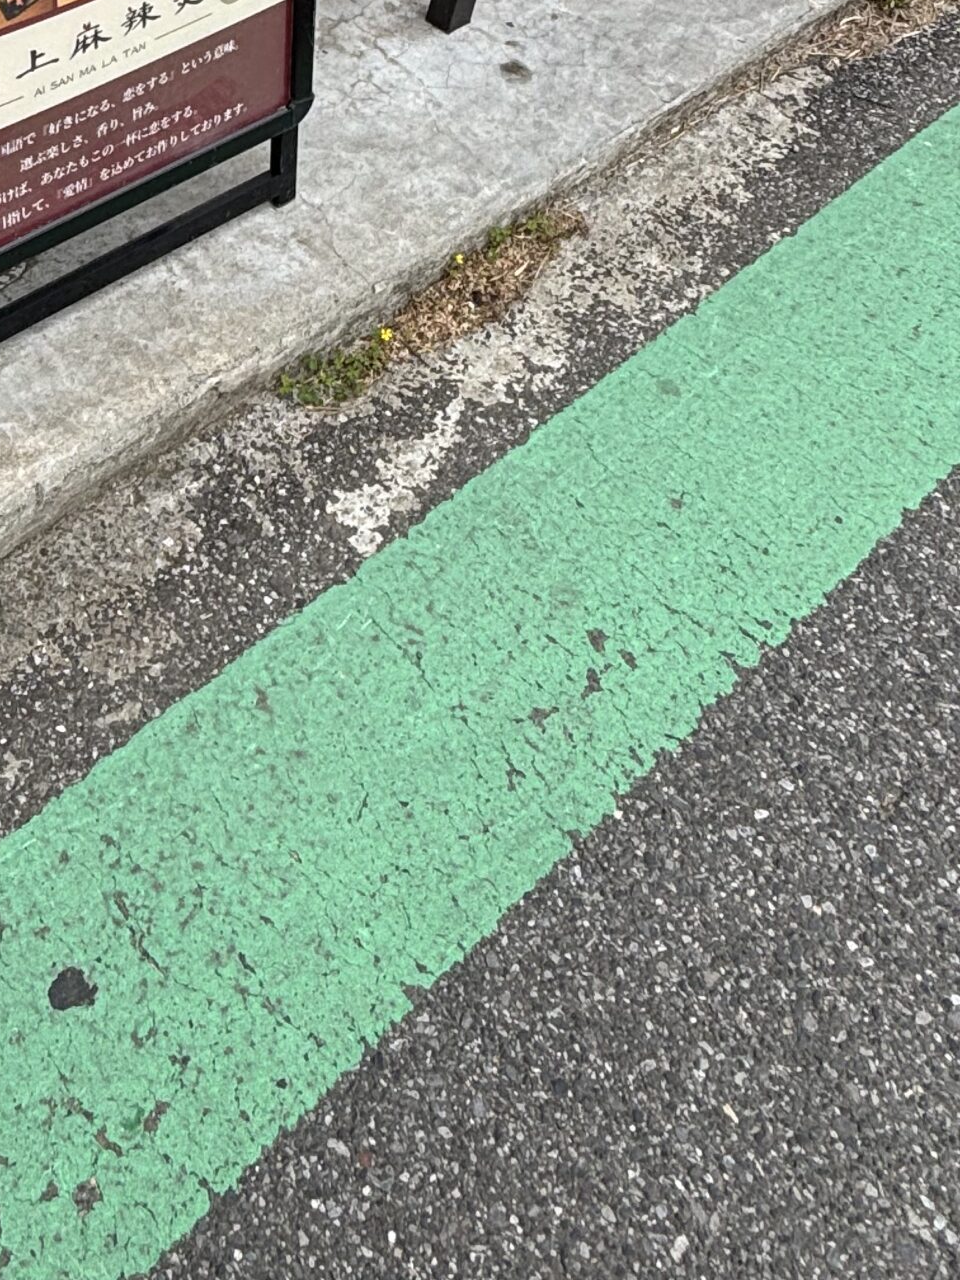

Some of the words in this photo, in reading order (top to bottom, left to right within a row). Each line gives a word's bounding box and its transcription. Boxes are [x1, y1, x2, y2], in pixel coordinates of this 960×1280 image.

[33, 85, 46, 98] AI
[50, 73, 75, 91] SAN
[78, 65, 97, 79] MA
[101, 55, 118, 69] LA
[122, 41, 147, 58] TAN
